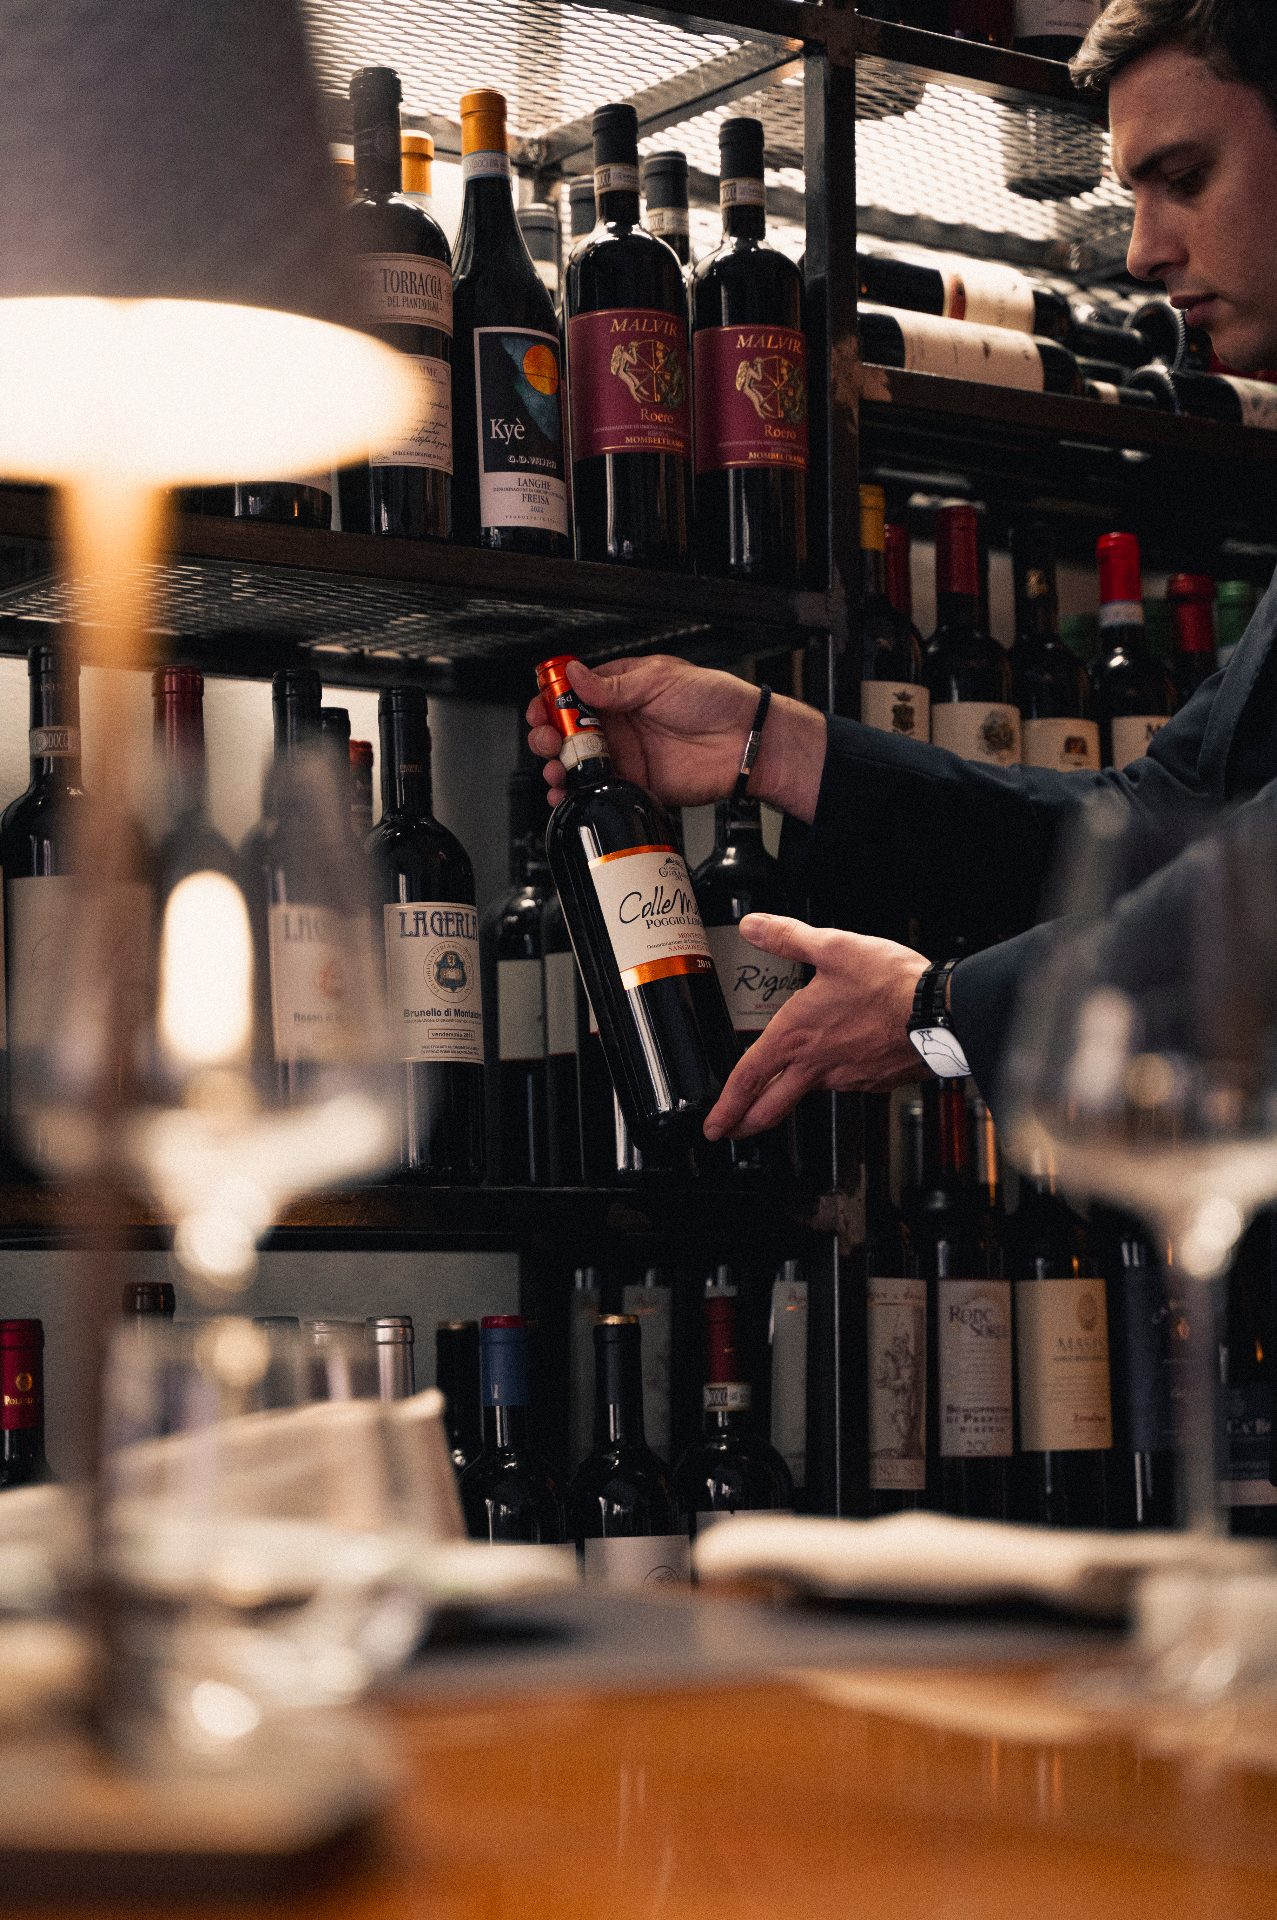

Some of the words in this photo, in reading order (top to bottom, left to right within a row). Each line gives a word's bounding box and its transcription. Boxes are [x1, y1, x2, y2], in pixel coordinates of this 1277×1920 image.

[640, 408, 674, 423] Roero
[490, 418, 525, 445] Kyè
[517, 477, 551, 491] LANGHE
[522, 493, 550, 505] FREISA
[645, 915, 686, 929] POGGIO
[403, 1007, 442, 1018] Brunello
[444, 1007, 452, 1018] di
